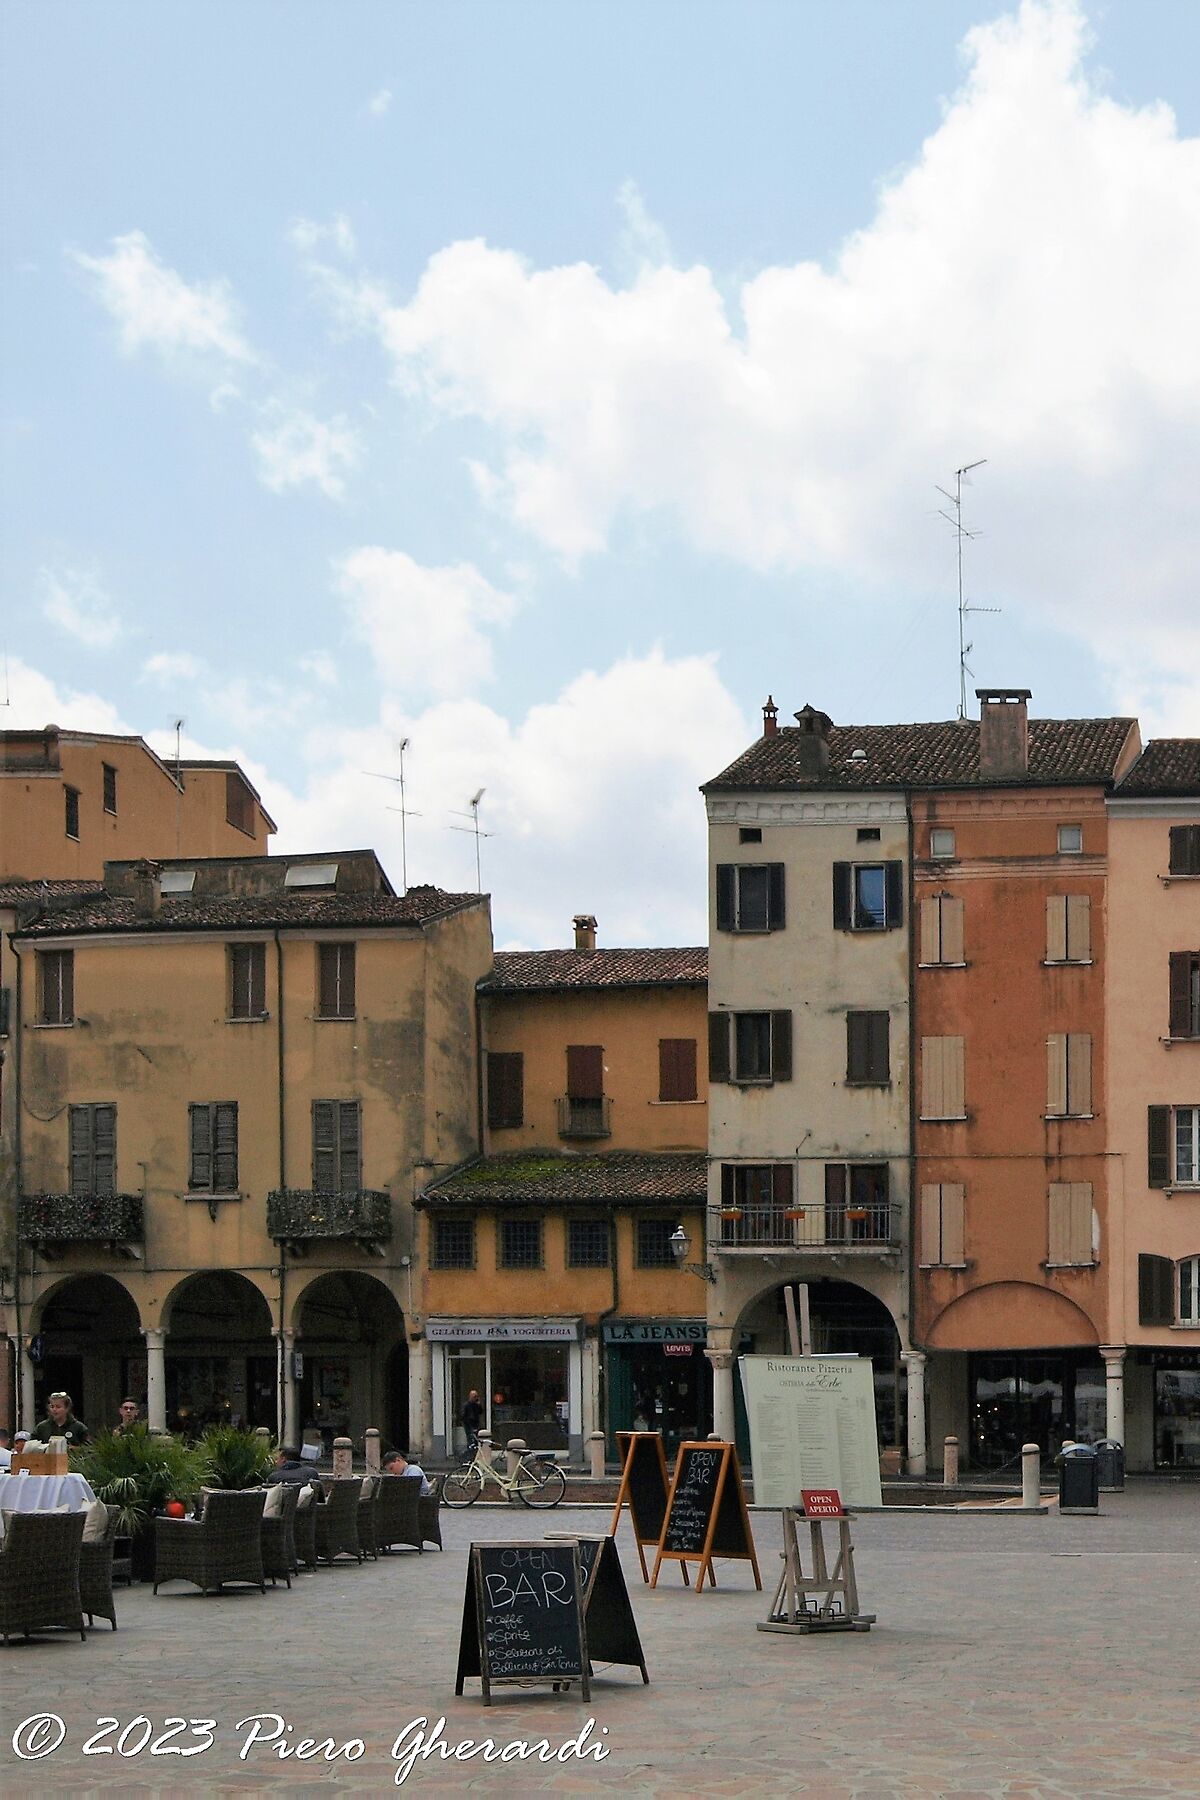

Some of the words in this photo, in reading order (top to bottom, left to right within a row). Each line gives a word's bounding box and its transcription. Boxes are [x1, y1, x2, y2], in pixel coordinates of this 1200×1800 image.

[431, 1327, 482, 1336] GELATERIA
[512, 1327, 571, 1336] YOGURTERIA
[610, 1326, 634, 1340] LA
[767, 1361, 816, 1373] Ristorante
[818, 1363, 853, 1374] Pizzeria
[690, 1451, 717, 1467] OPEN
[687, 1466, 710, 1484] BAR
[810, 1495, 832, 1504] OPEN
[808, 1505, 839, 1513] APERTO
[500, 1549, 555, 1569] OPEN
[485, 1571, 574, 1608] BAR
